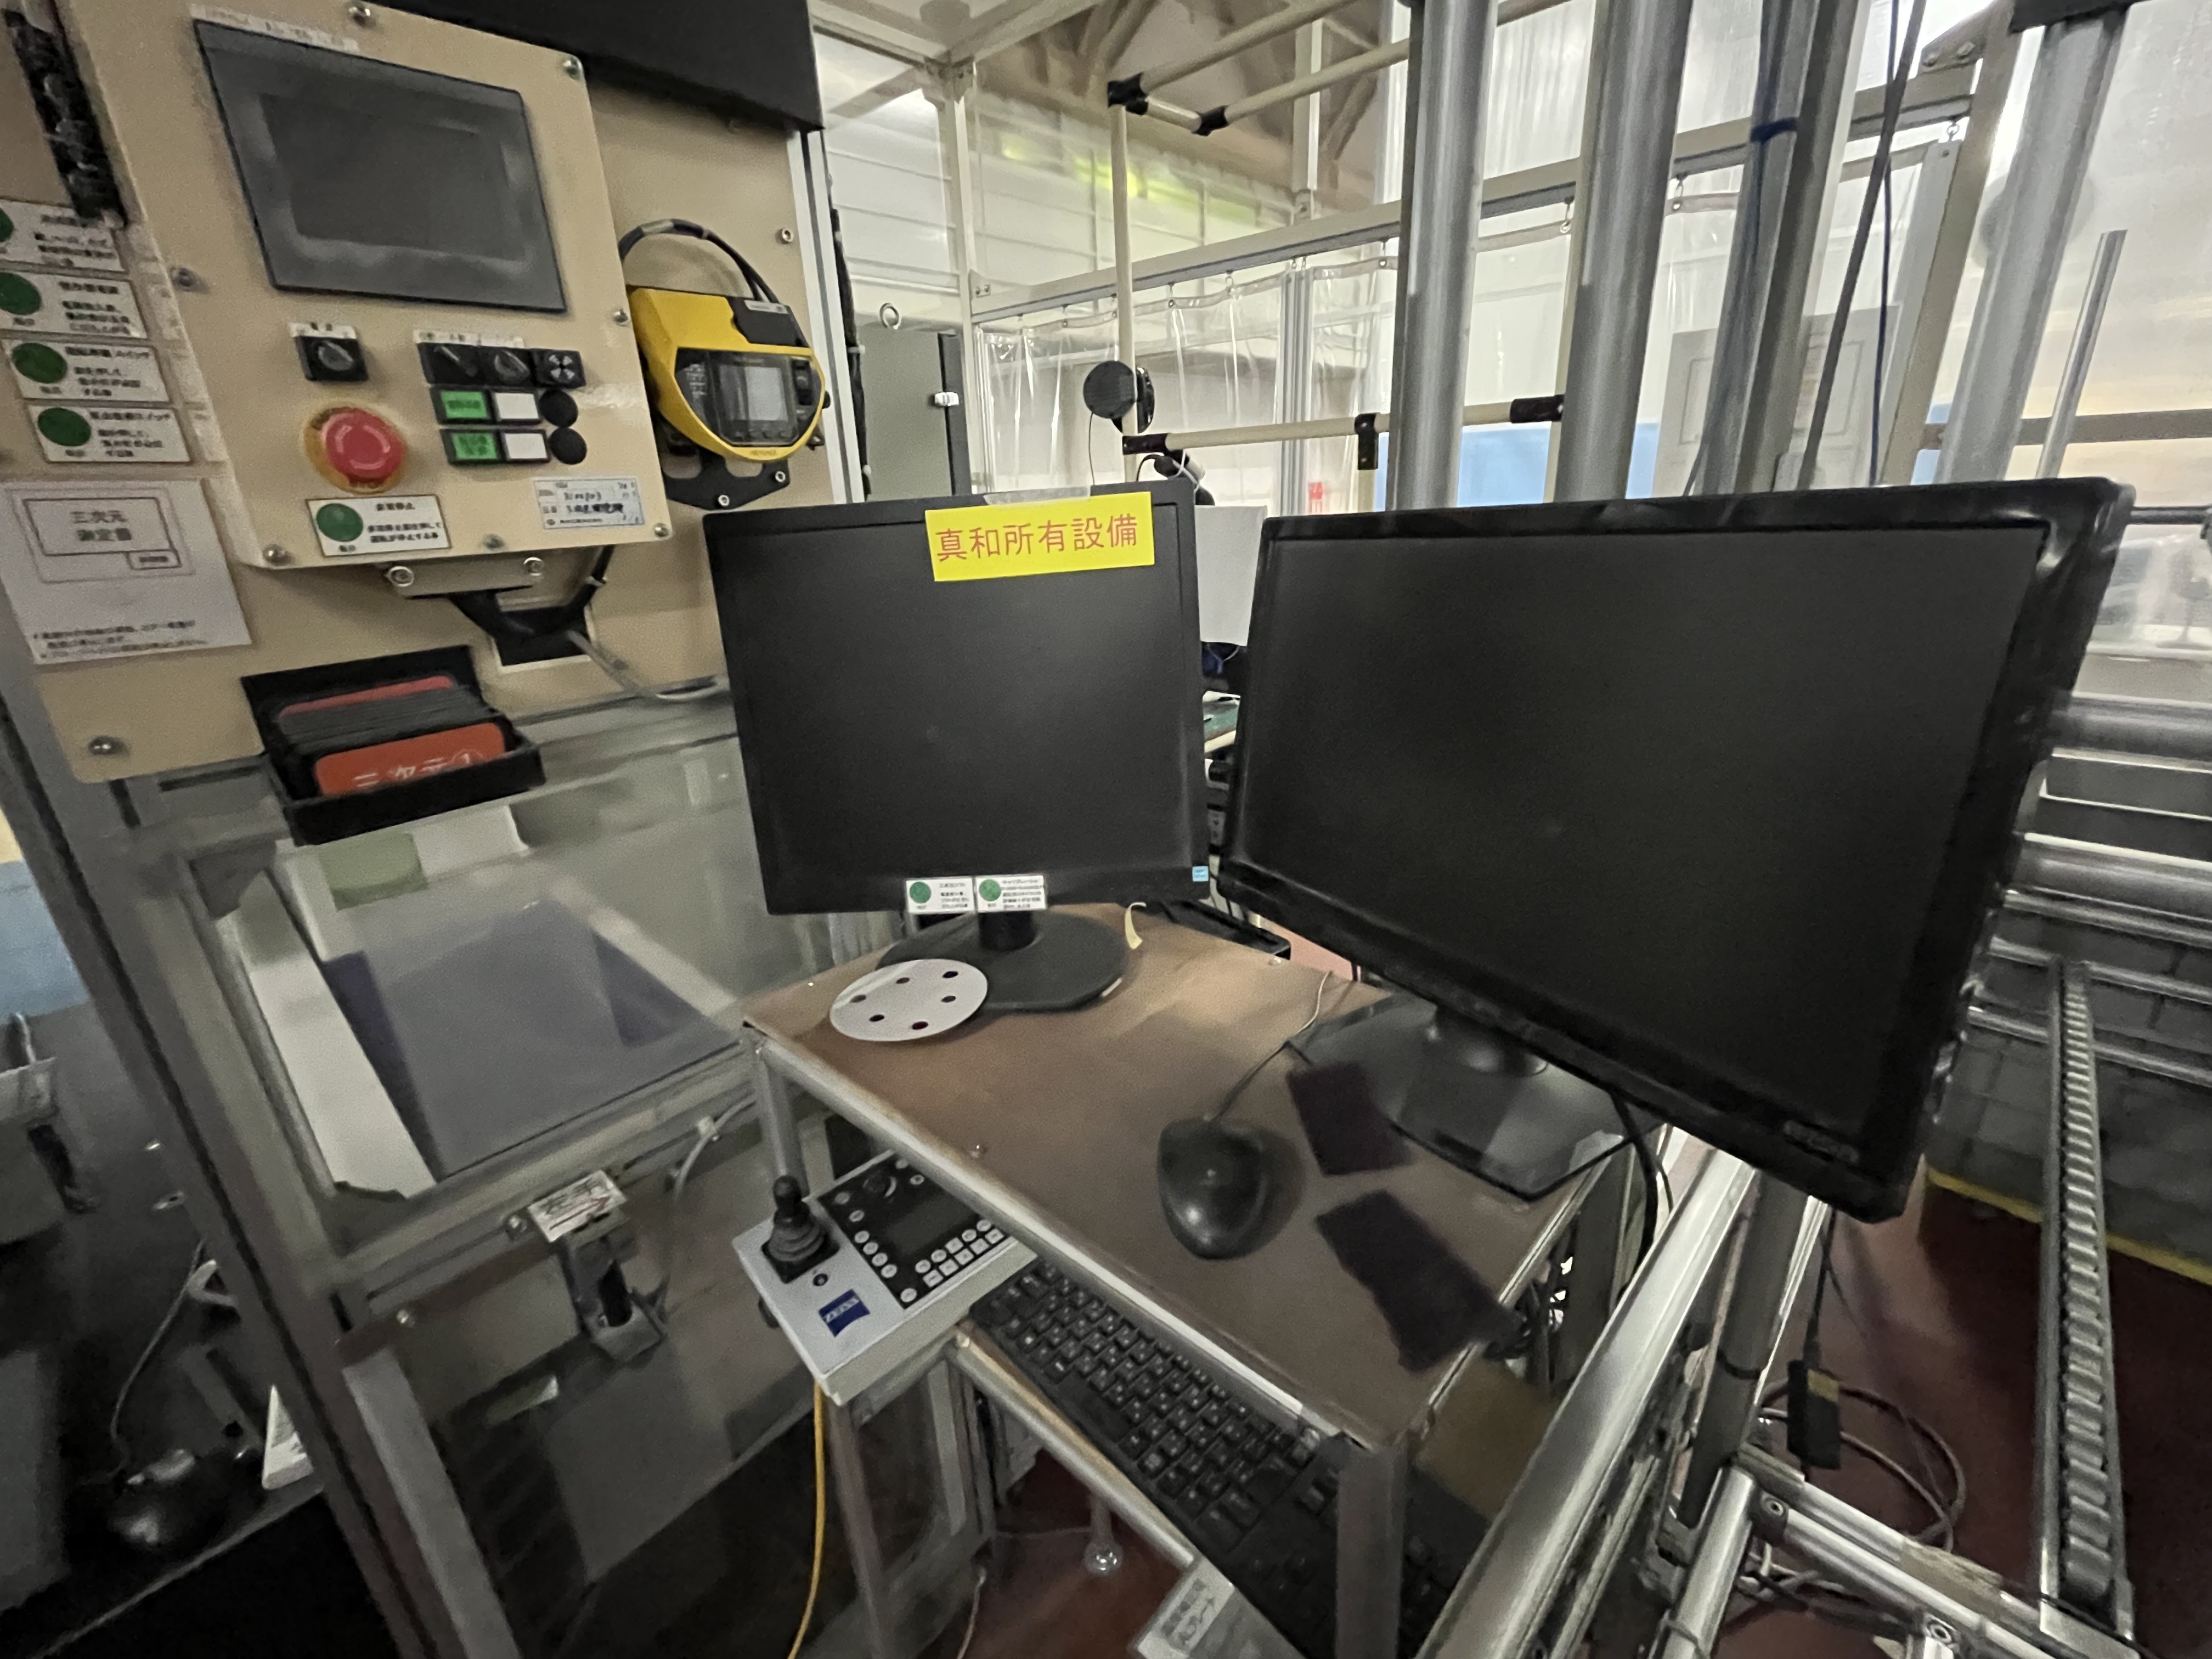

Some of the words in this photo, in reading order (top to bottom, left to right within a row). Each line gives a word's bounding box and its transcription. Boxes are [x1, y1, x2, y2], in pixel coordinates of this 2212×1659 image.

[935, 513, 1138, 562] 真和所有設備
[823, 1296, 860, 1323] ZEISS
